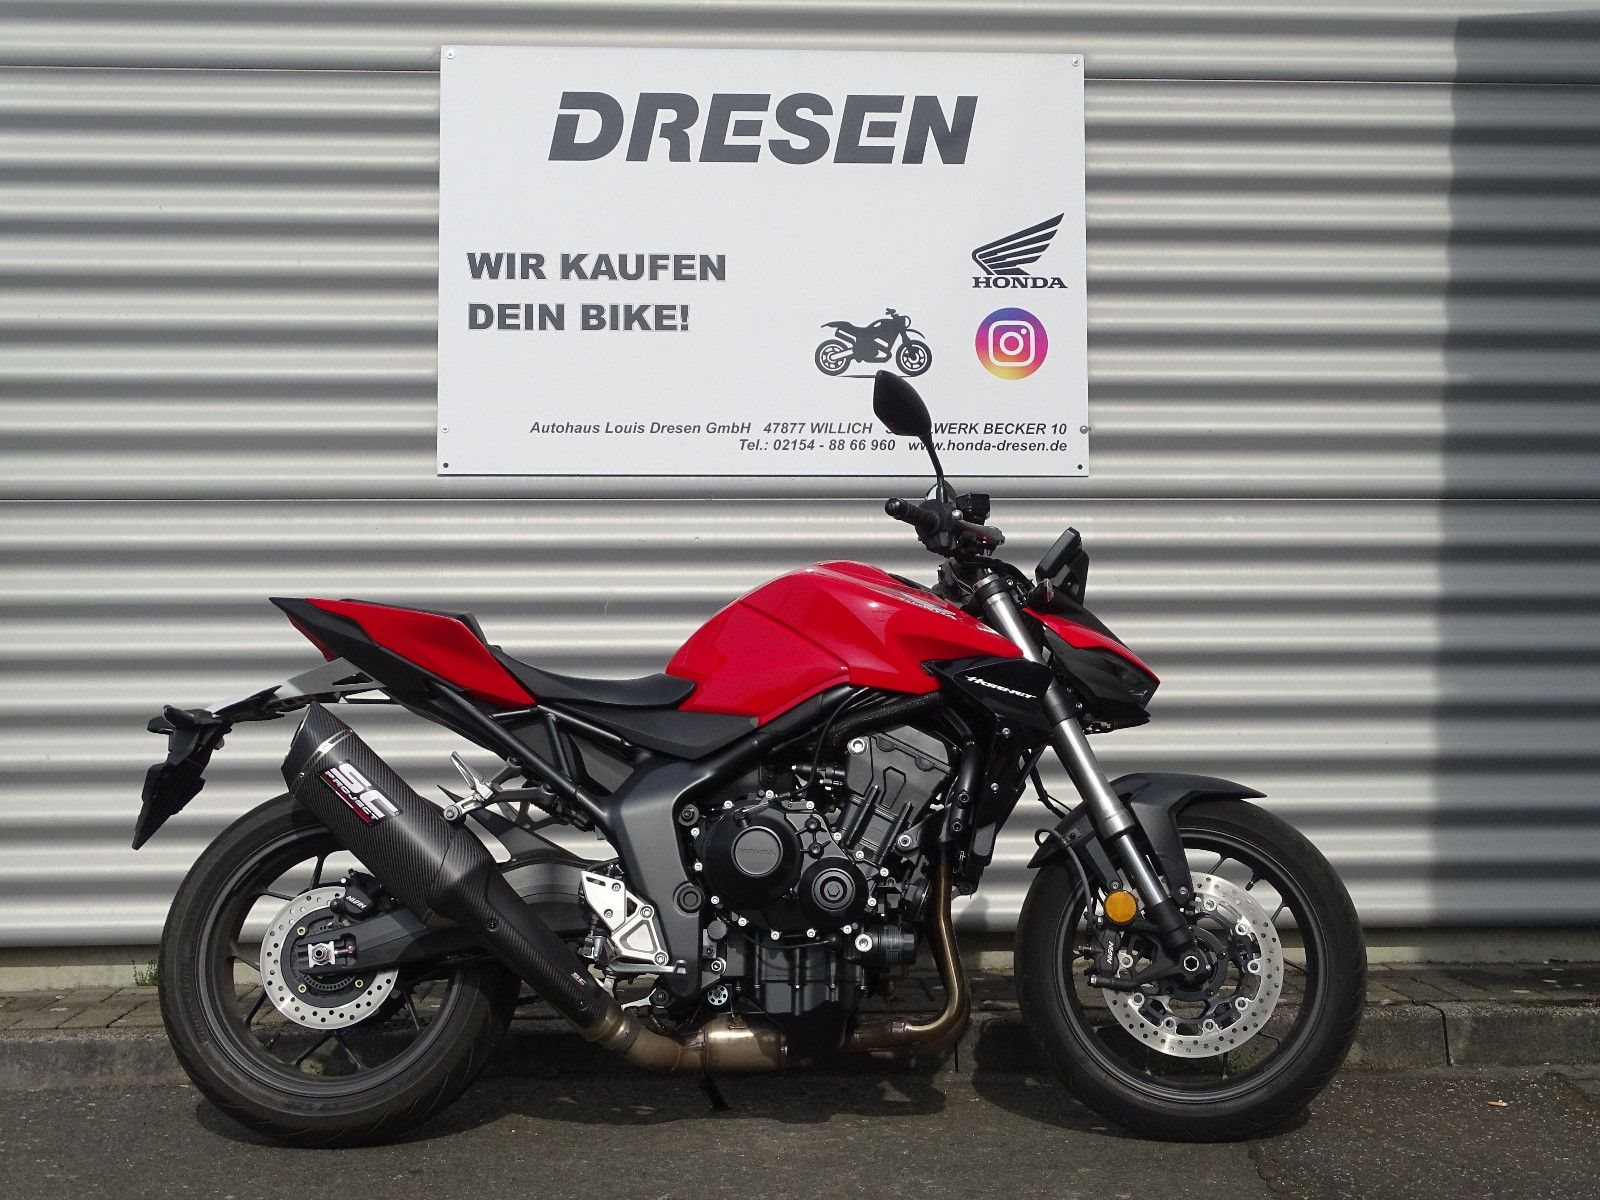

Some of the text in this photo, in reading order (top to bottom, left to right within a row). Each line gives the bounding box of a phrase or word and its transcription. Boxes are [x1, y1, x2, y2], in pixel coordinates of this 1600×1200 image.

[548, 91, 978, 165] DRESEN
[466, 252, 726, 281] WIR KAUFEN
[972, 276, 1068, 289] HONDA
[468, 303, 689, 331] DEIN BIKE!
[530, 421, 600, 434] Autohaus
[605, 421, 645, 434] Louis
[650, 421, 701, 434] Dresen
[706, 421, 752, 434] GmbH
[763, 422, 806, 434] 47877
[811, 422, 873, 435] WILLICH
[983, 422, 1047, 435] BECKER
[1051, 422, 1068, 435] 10
[740, 438, 769, 451] Tel.:
[773, 438, 815, 451] 02154
[828, 438, 846, 451] 88
[849, 439, 867, 451] 66
[870, 438, 896, 451] 960
[324, 770, 379, 821] PROJECT
[329, 762, 399, 818] SC
